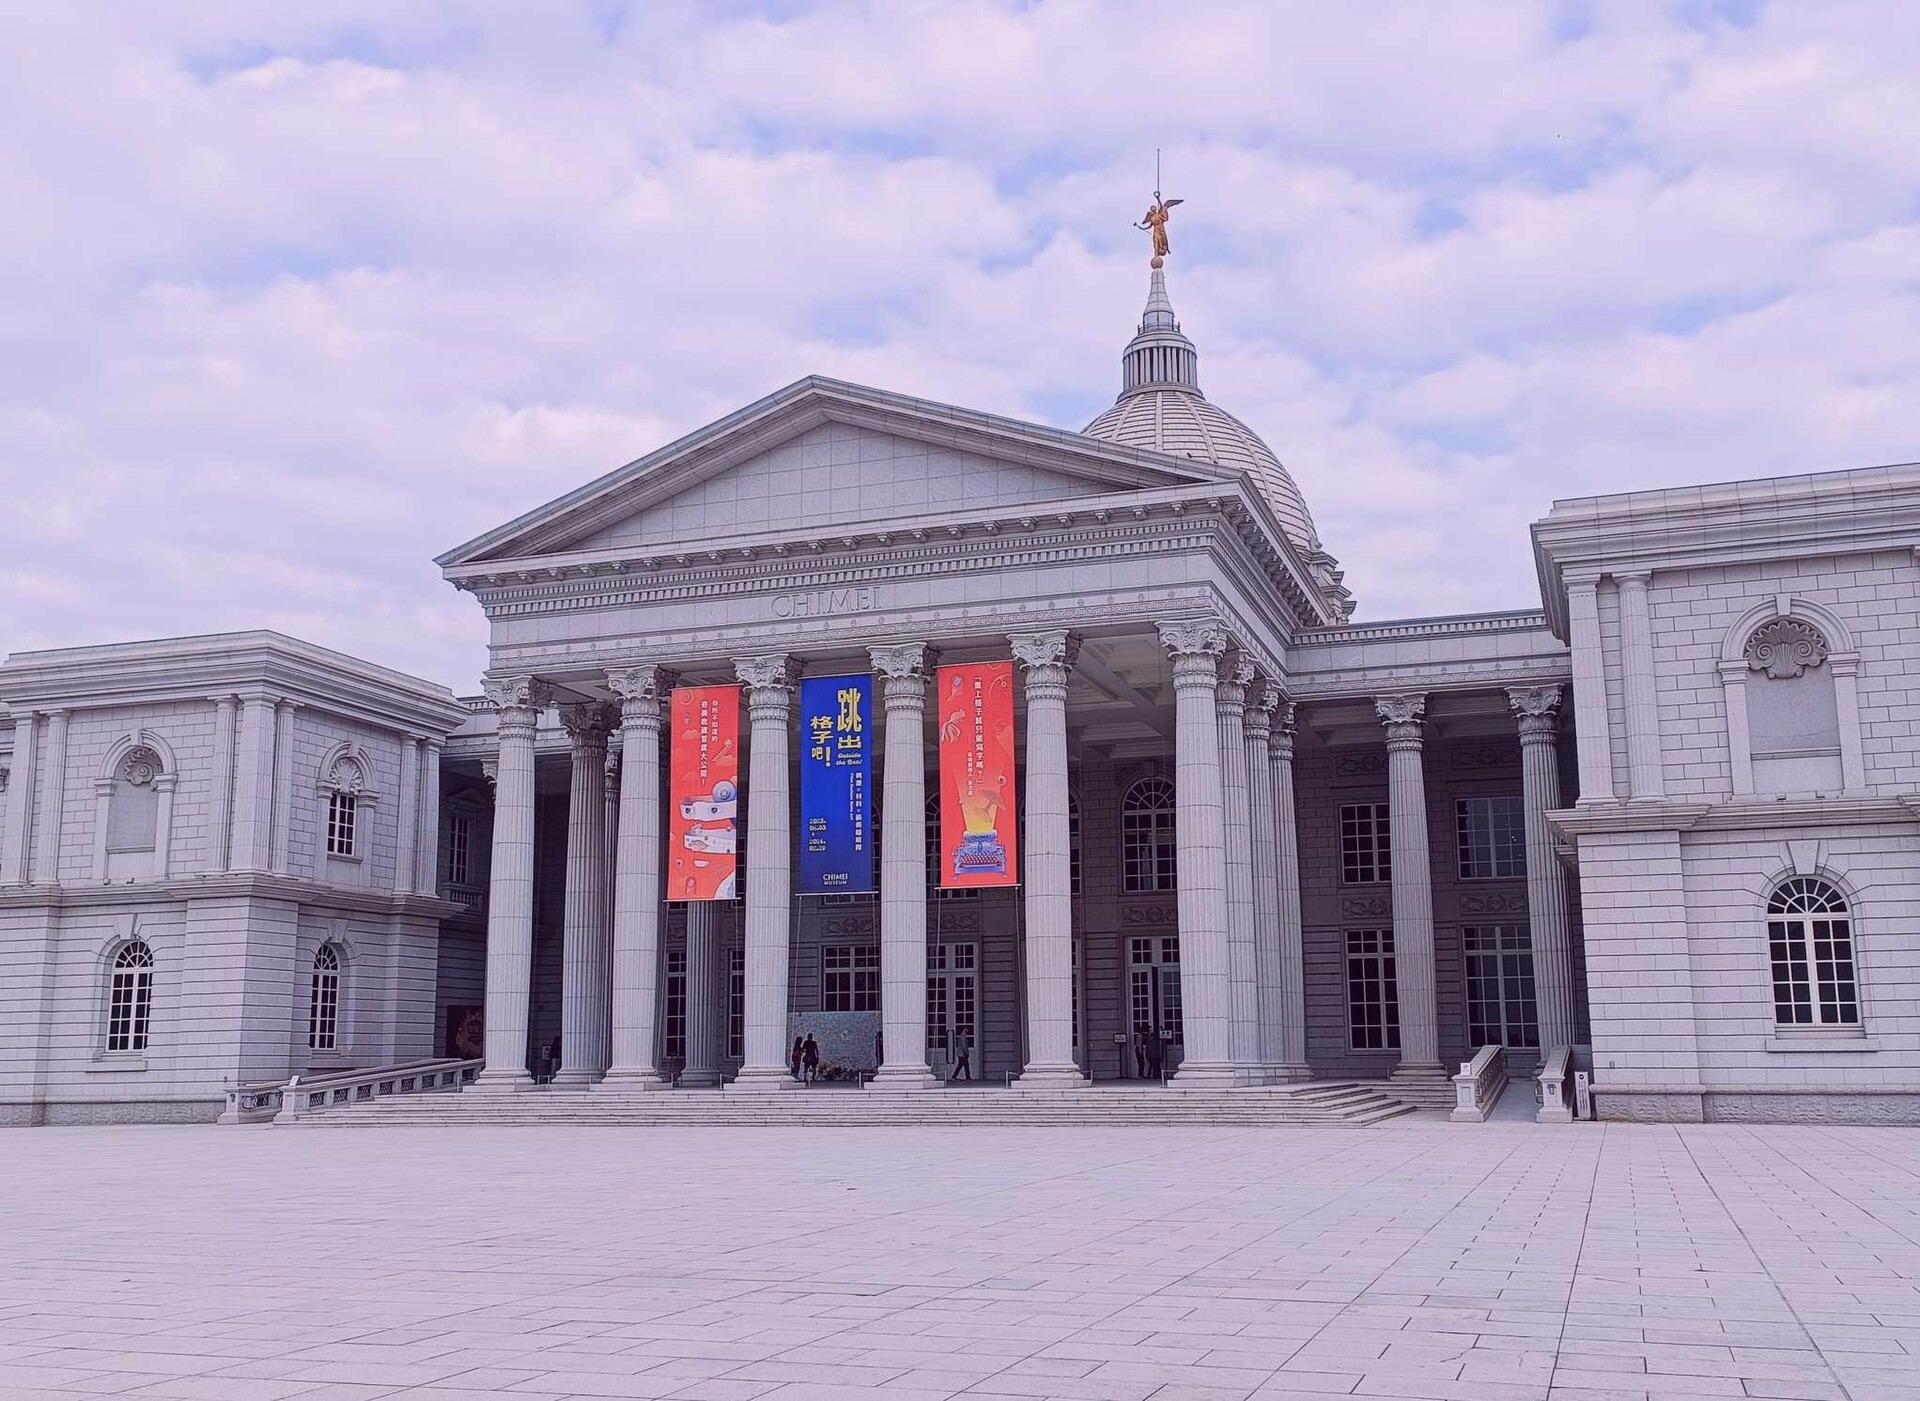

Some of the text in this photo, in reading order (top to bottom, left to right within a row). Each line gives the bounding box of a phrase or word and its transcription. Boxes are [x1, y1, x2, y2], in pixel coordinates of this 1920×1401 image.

[771, 587, 882, 617] CHIMEI
[837, 687, 863, 749] 跳出
[810, 715, 834, 767] 格子吧!
[822, 873, 849, 881] CHIMEI
